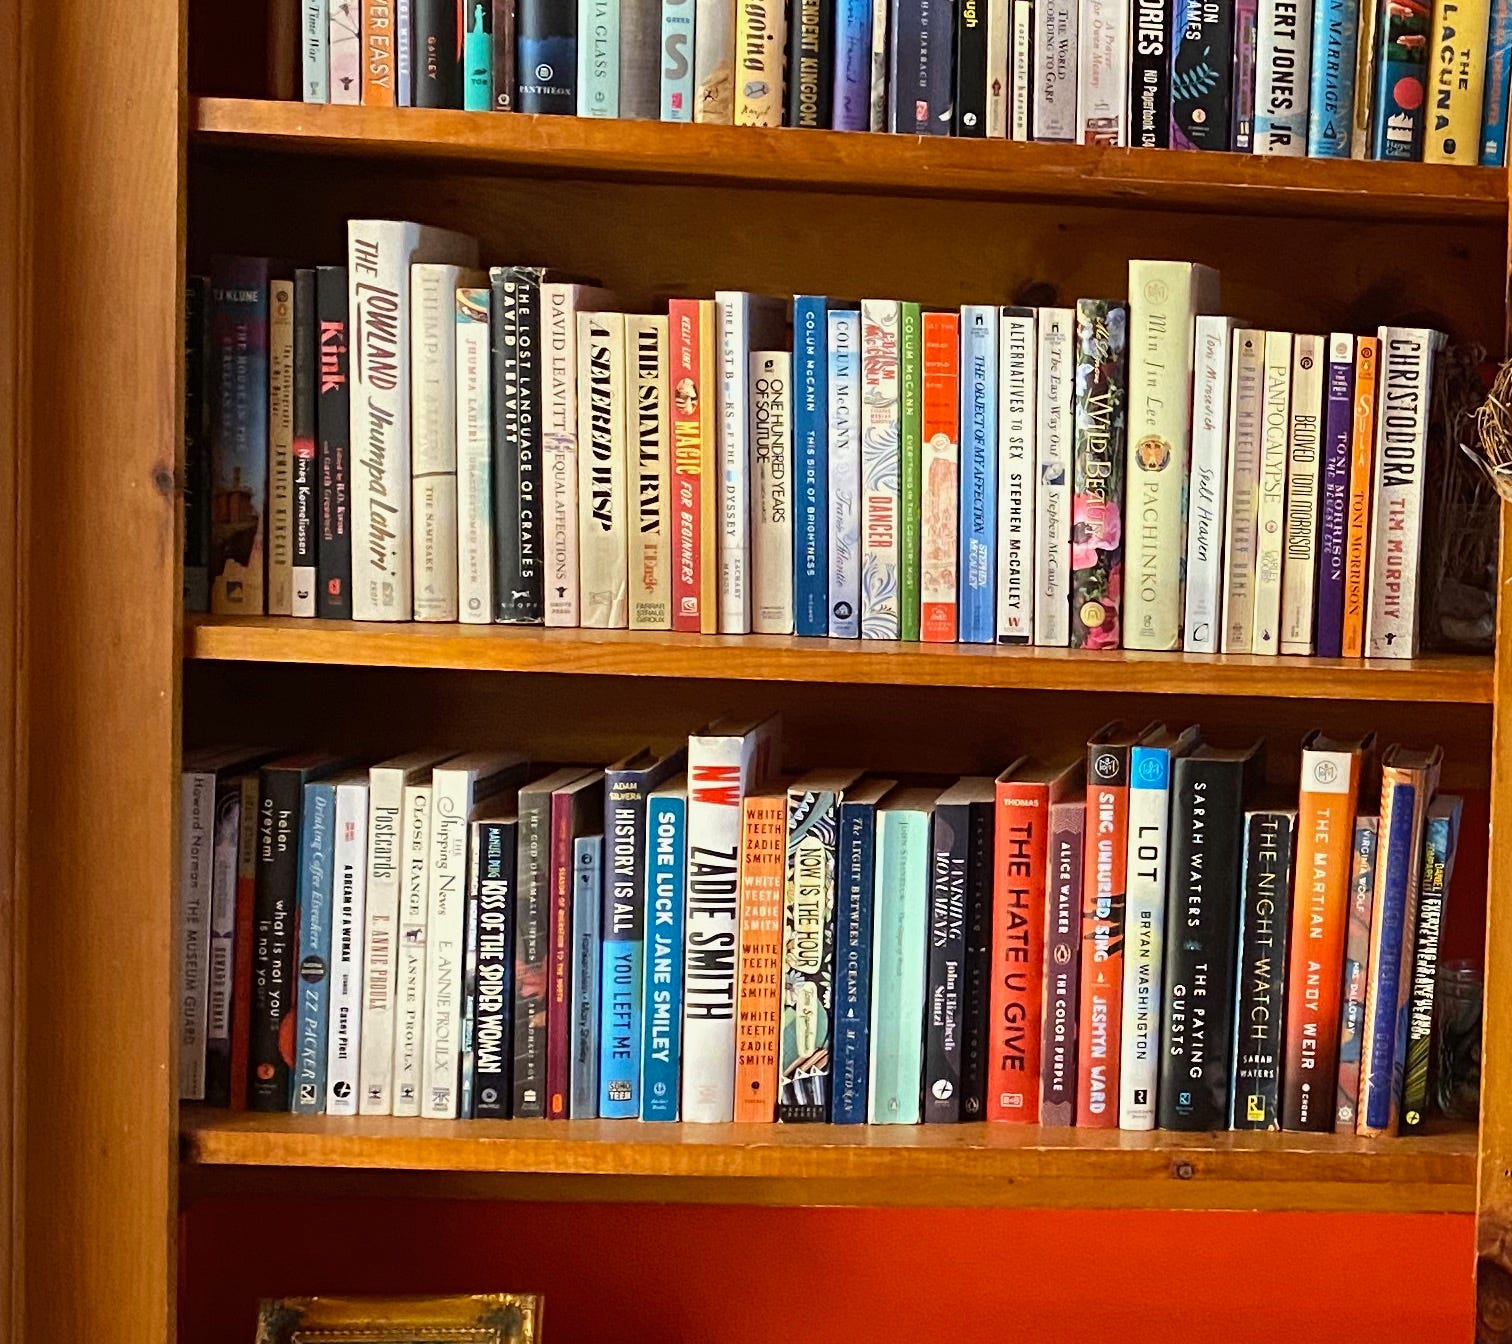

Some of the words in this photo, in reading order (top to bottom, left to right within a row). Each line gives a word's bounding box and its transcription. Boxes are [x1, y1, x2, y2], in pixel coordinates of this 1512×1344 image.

[370, 35, 390, 89] EASY
[800, 56, 818, 126] KINGDOM
[1269, 46, 1296, 116] JONES,
[1435, 3, 1456, 132] LACUNA
[1458, 48, 1471, 91] THE
[1268, 122, 1291, 152] JR.
[354, 239, 380, 278] THE
[356, 283, 399, 391] LOWLAND
[504, 282, 516, 346] DAVID
[320, 320, 346, 395] Kink
[638, 328, 659, 379] THE
[505, 360, 517, 444] LEAVITT
[639, 386, 659, 467] SMALL
[1382, 339, 1421, 488] CHRISTODORA
[360, 396, 395, 496] Jhumpa
[675, 421, 701, 475] MAGIC
[640, 474, 660, 535] RAIN
[868, 496, 893, 548] DANCER
[367, 498, 399, 576] Lahiri
[692, 765, 740, 807] NW
[1192, 783, 1206, 844] SARAH
[614, 808, 634, 876] HISTORY
[657, 812, 675, 865] SOME
[1008, 822, 1032, 878] THE
[1137, 826, 1158, 882] LOT
[1316, 808, 1330, 843] THE
[614, 882, 631, 898] IS
[655, 873, 674, 925] LUCK
[689, 846, 738, 920] ZADIE
[1187, 854, 1203, 927] WATERS
[1309, 853, 1328, 939] MARTIAN
[613, 903, 631, 933] ALL
[1006, 889, 1030, 963] HATE
[654, 934, 672, 984] JANE
[687, 932, 736, 1019] SMITH
[1005, 973, 1025, 992] U
[651, 991, 670, 1062] SMILEY
[1001, 1002, 1025, 1072] GIVE
